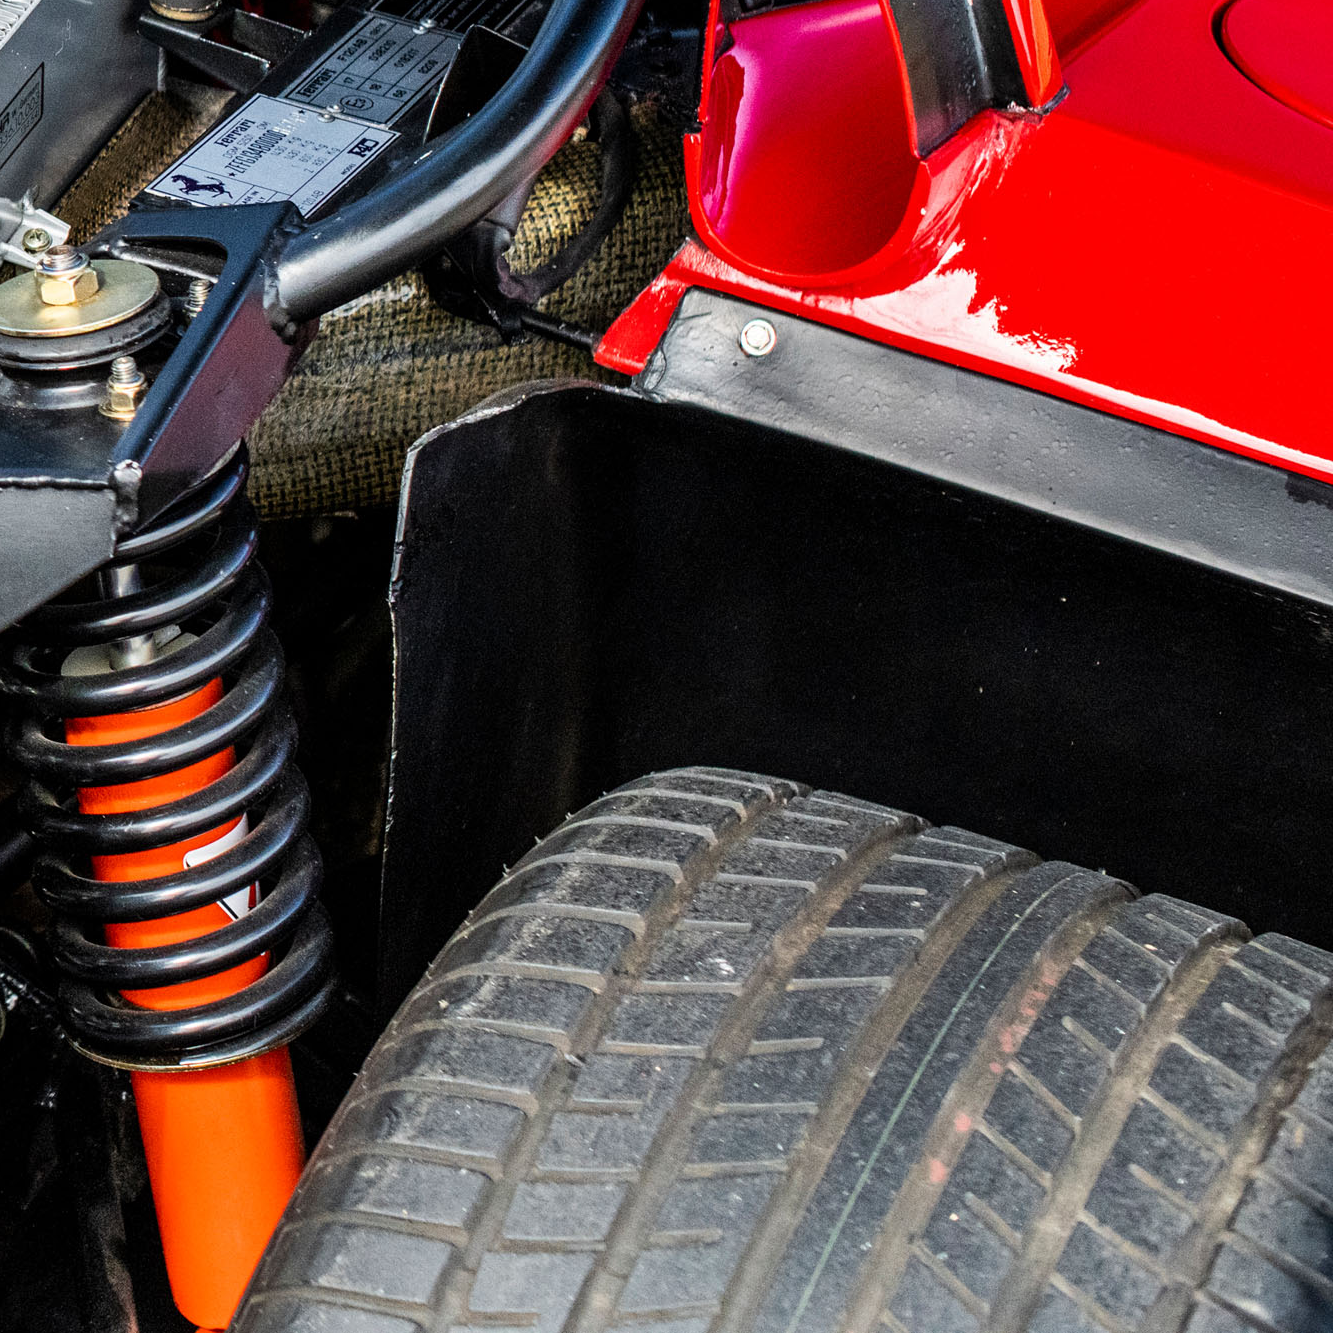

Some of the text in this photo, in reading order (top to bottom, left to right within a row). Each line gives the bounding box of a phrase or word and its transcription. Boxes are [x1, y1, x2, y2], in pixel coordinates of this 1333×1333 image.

[297, 67, 337, 98] Ferrari
[214, 118, 256, 147] Ferrari
[346, 137, 380, 158] F40
